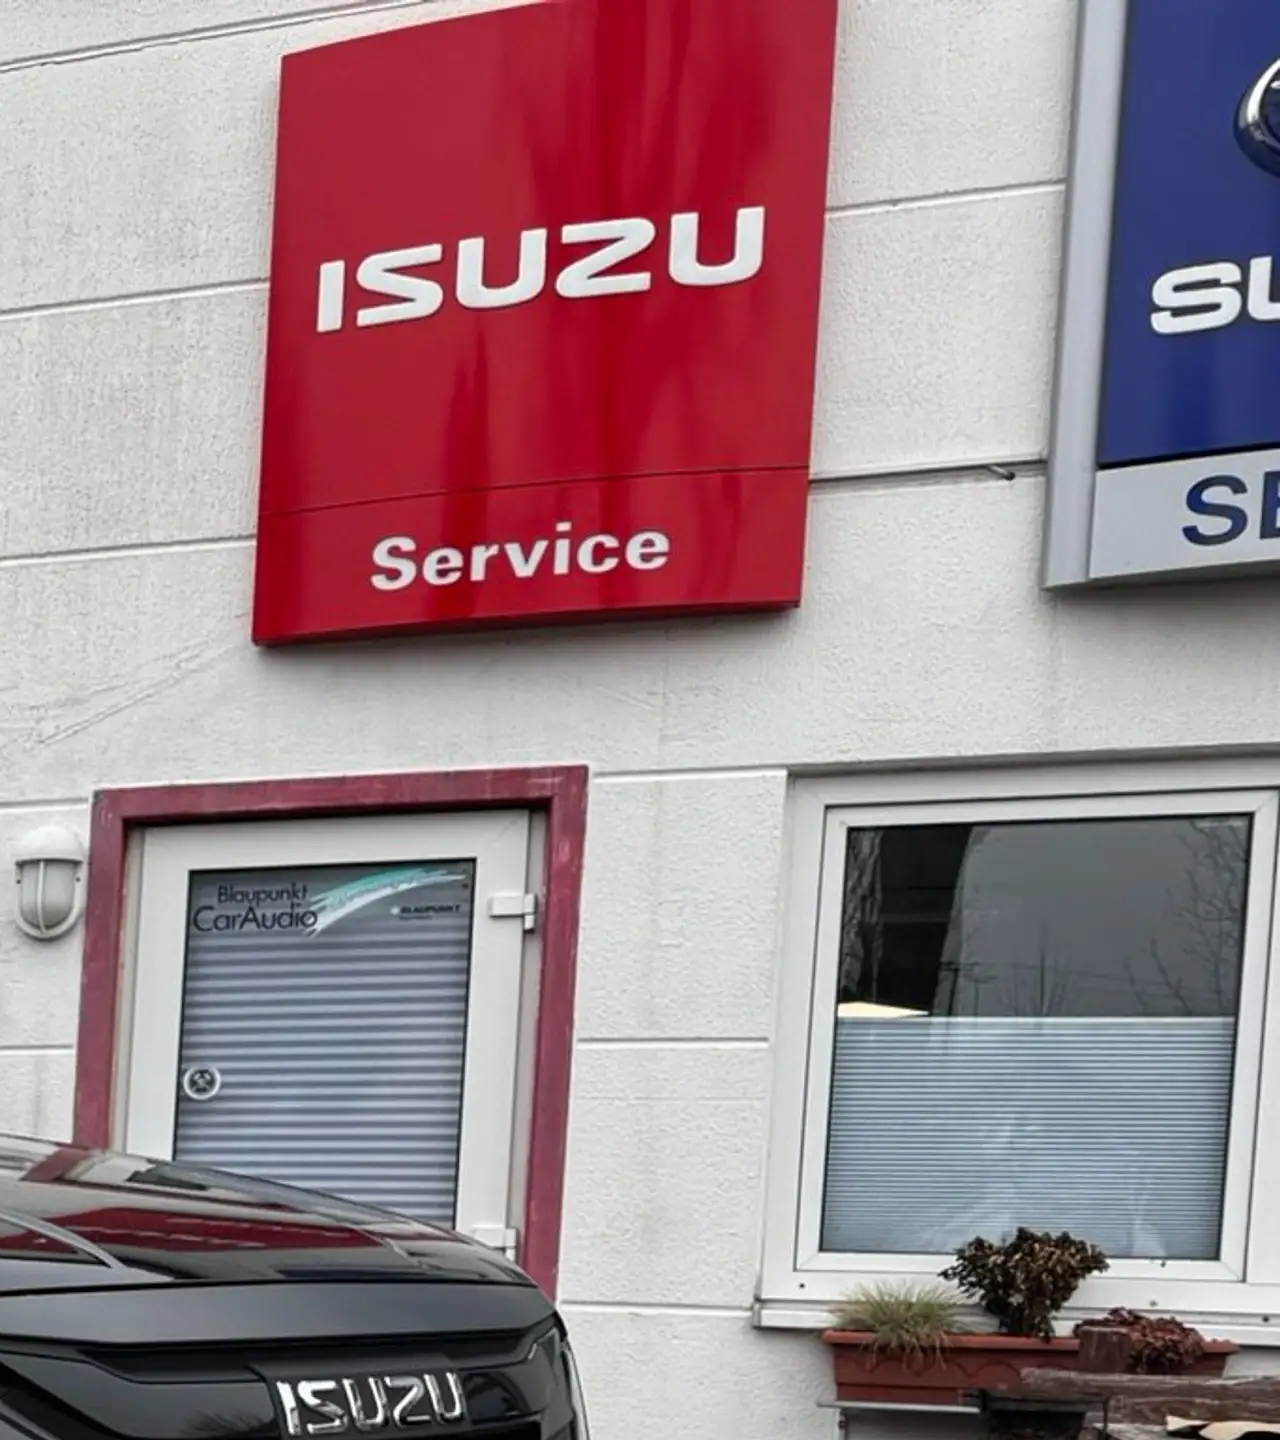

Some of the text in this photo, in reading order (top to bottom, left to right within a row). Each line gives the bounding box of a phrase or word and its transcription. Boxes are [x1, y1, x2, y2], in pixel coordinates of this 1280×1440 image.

[316, 206, 765, 333] ISUZU
[370, 521, 670, 591] Service
[193, 902, 318, 932] CarAudio
[218, 881, 308, 908] Blaupunkt
[276, 1371, 466, 1436] ISUZU
